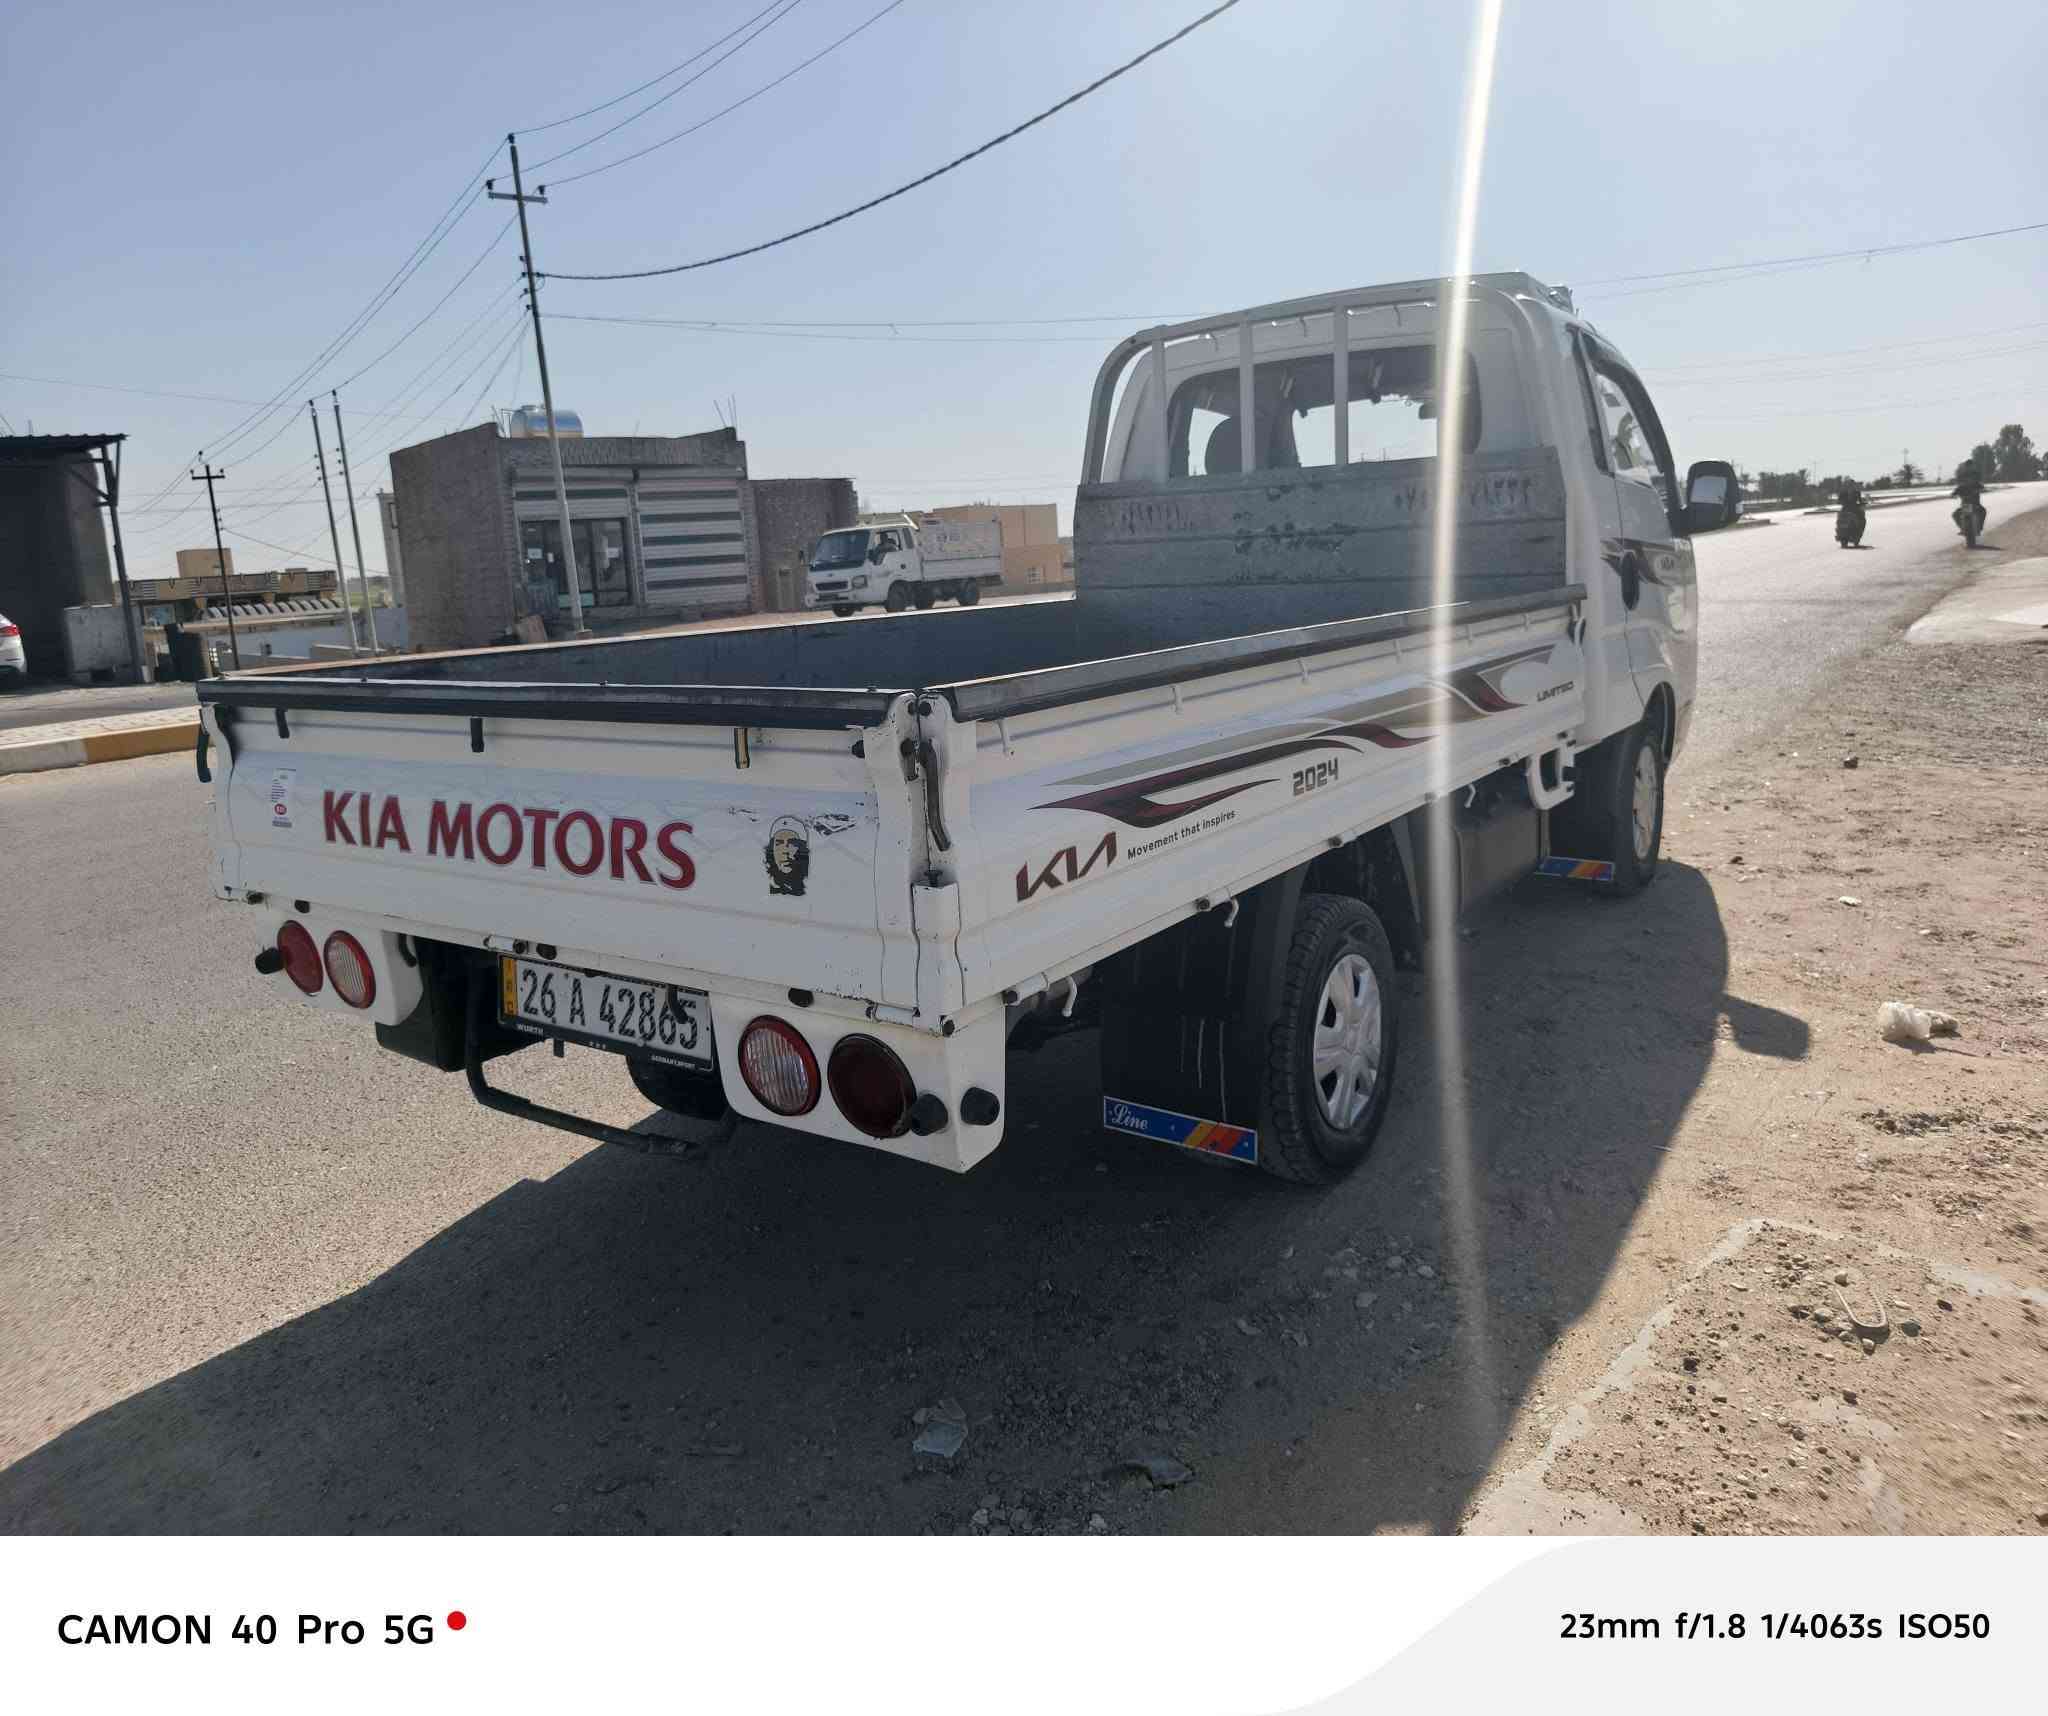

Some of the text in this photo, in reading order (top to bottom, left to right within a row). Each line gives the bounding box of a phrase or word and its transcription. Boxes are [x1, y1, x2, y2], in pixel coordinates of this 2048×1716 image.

[1292, 757, 1339, 796] 2024
[322, 789, 412, 853] KIA
[427, 798, 697, 890] MOTORS
[1127, 809, 1237, 860] Movement that inspires
[1015, 830, 1118, 903] KIA
[522, 969, 699, 1050] 26 A 42865
[1111, 1103, 1149, 1130] Line
